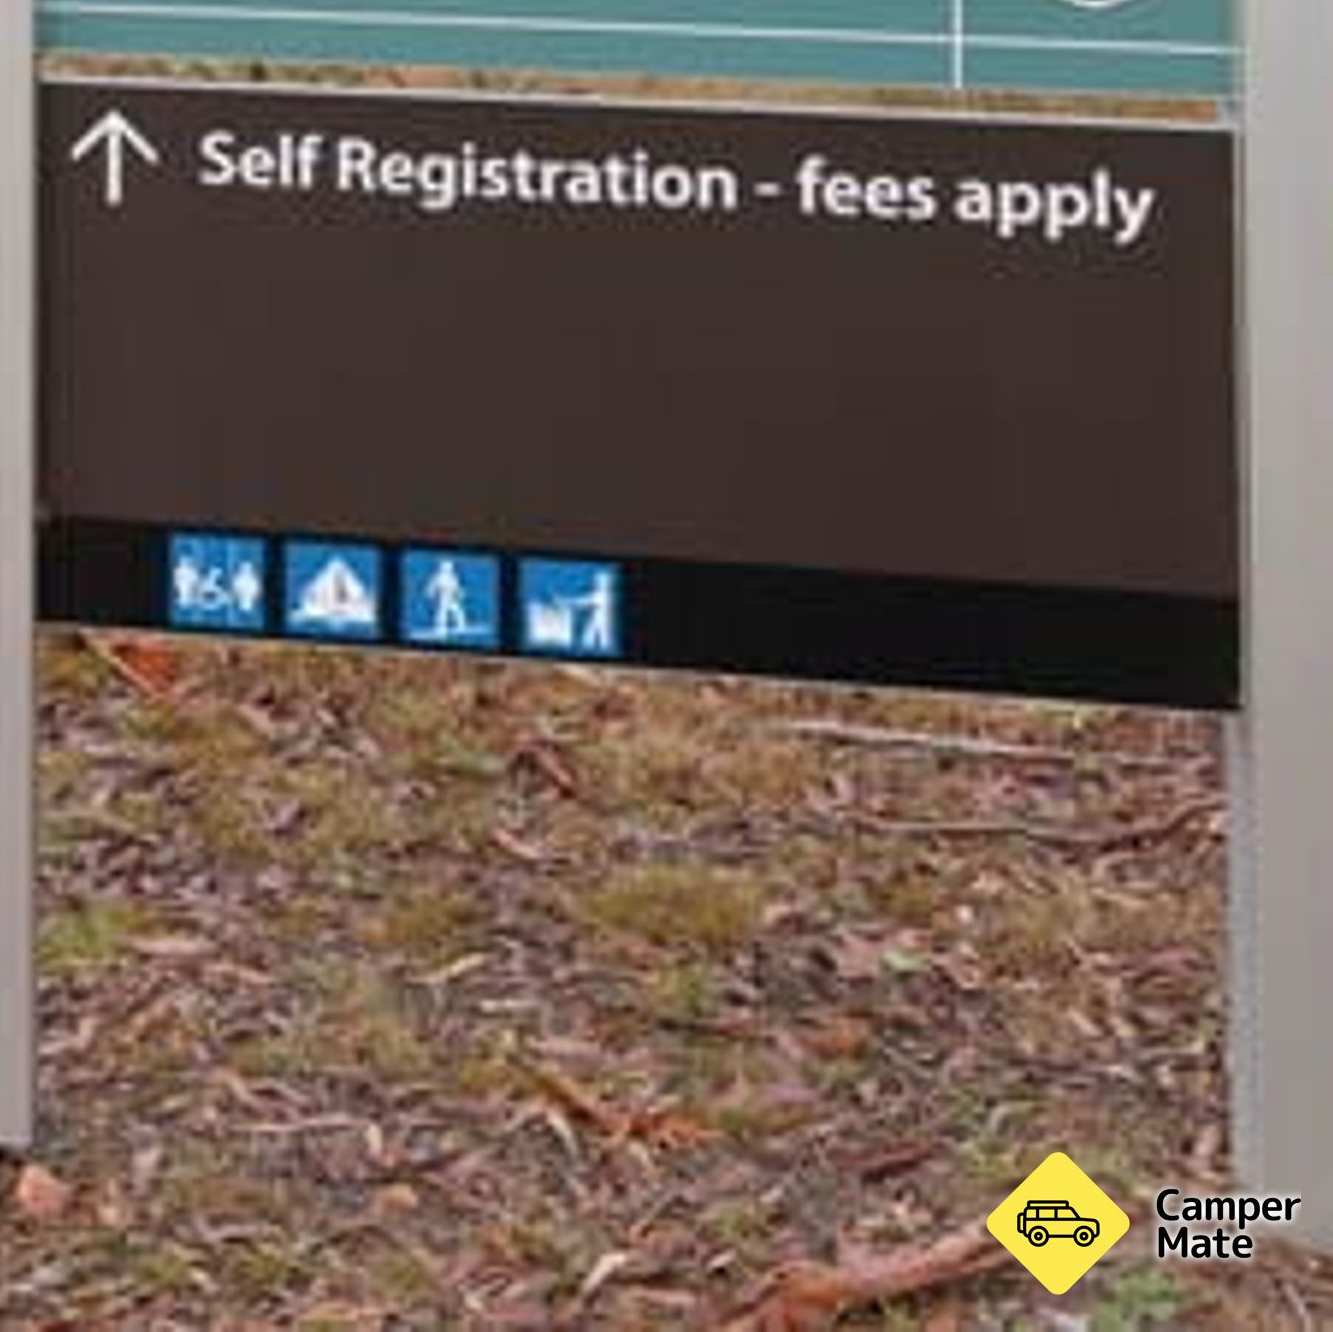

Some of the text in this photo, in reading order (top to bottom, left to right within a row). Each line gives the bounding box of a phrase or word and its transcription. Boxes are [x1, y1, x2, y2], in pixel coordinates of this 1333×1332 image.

[200, 129, 324, 190] Self
[336, 136, 738, 210] Registration
[796, 154, 938, 221] fees
[954, 169, 1154, 245] apply
